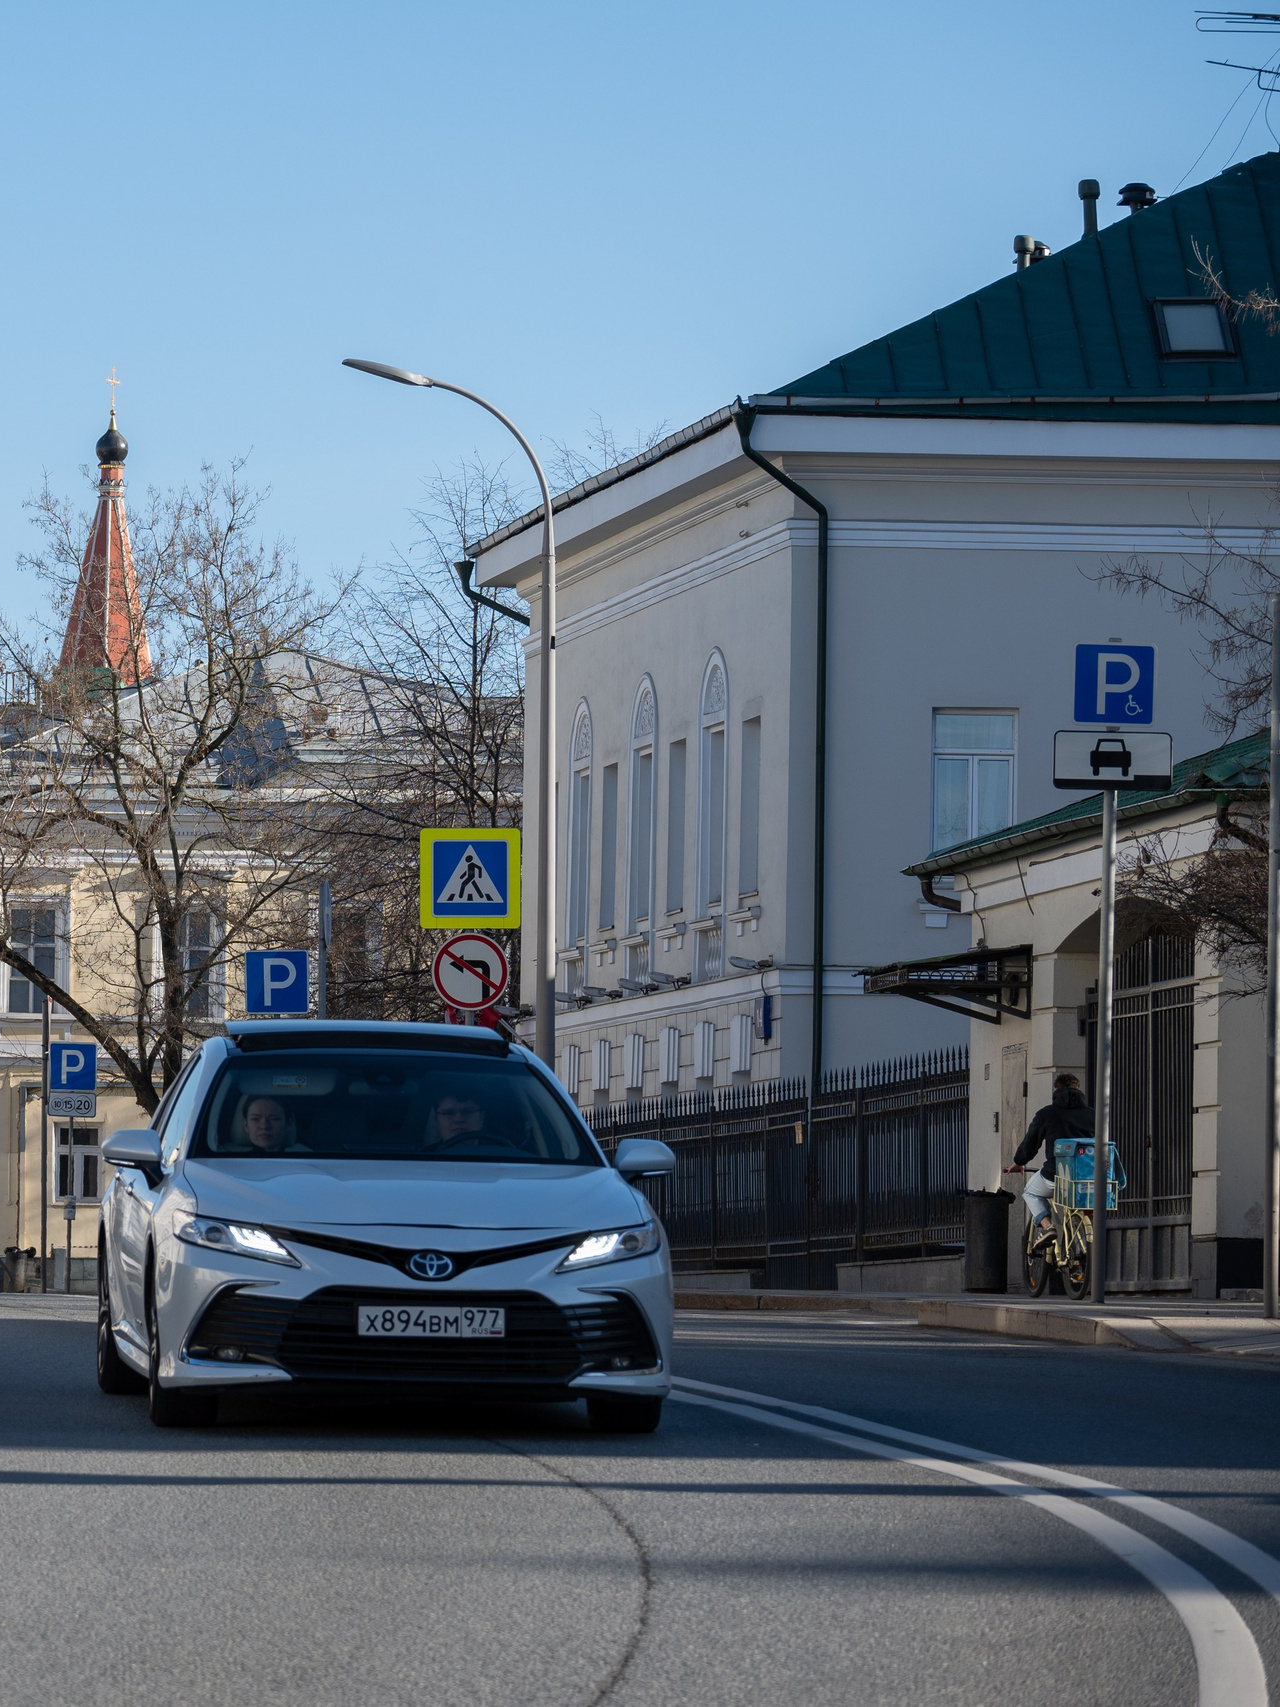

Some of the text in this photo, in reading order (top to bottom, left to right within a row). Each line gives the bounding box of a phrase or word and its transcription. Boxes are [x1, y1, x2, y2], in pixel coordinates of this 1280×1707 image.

[1096, 652, 1140, 715] P
[263, 957, 297, 1007] P
[61, 1049, 85, 1085] P
[53, 1099, 91, 1111] 10 15 20
[464, 1309, 500, 1328] 977
[471, 1327, 489, 1335] RUS
